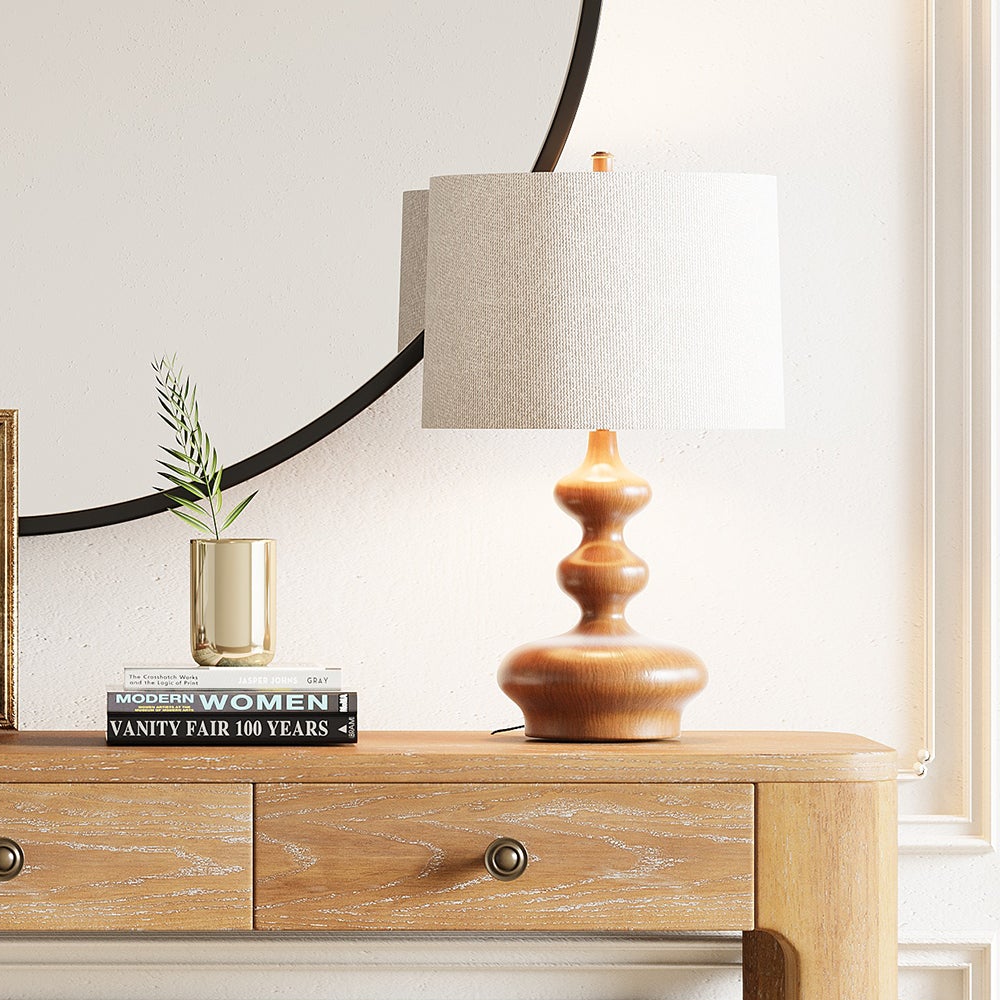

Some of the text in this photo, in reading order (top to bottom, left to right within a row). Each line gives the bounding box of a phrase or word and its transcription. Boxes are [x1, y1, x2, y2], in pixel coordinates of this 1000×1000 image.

[116, 694, 328, 711] MODERN WOMEN
[110, 720, 328, 737] VANITY FAIR 100 YEARS
